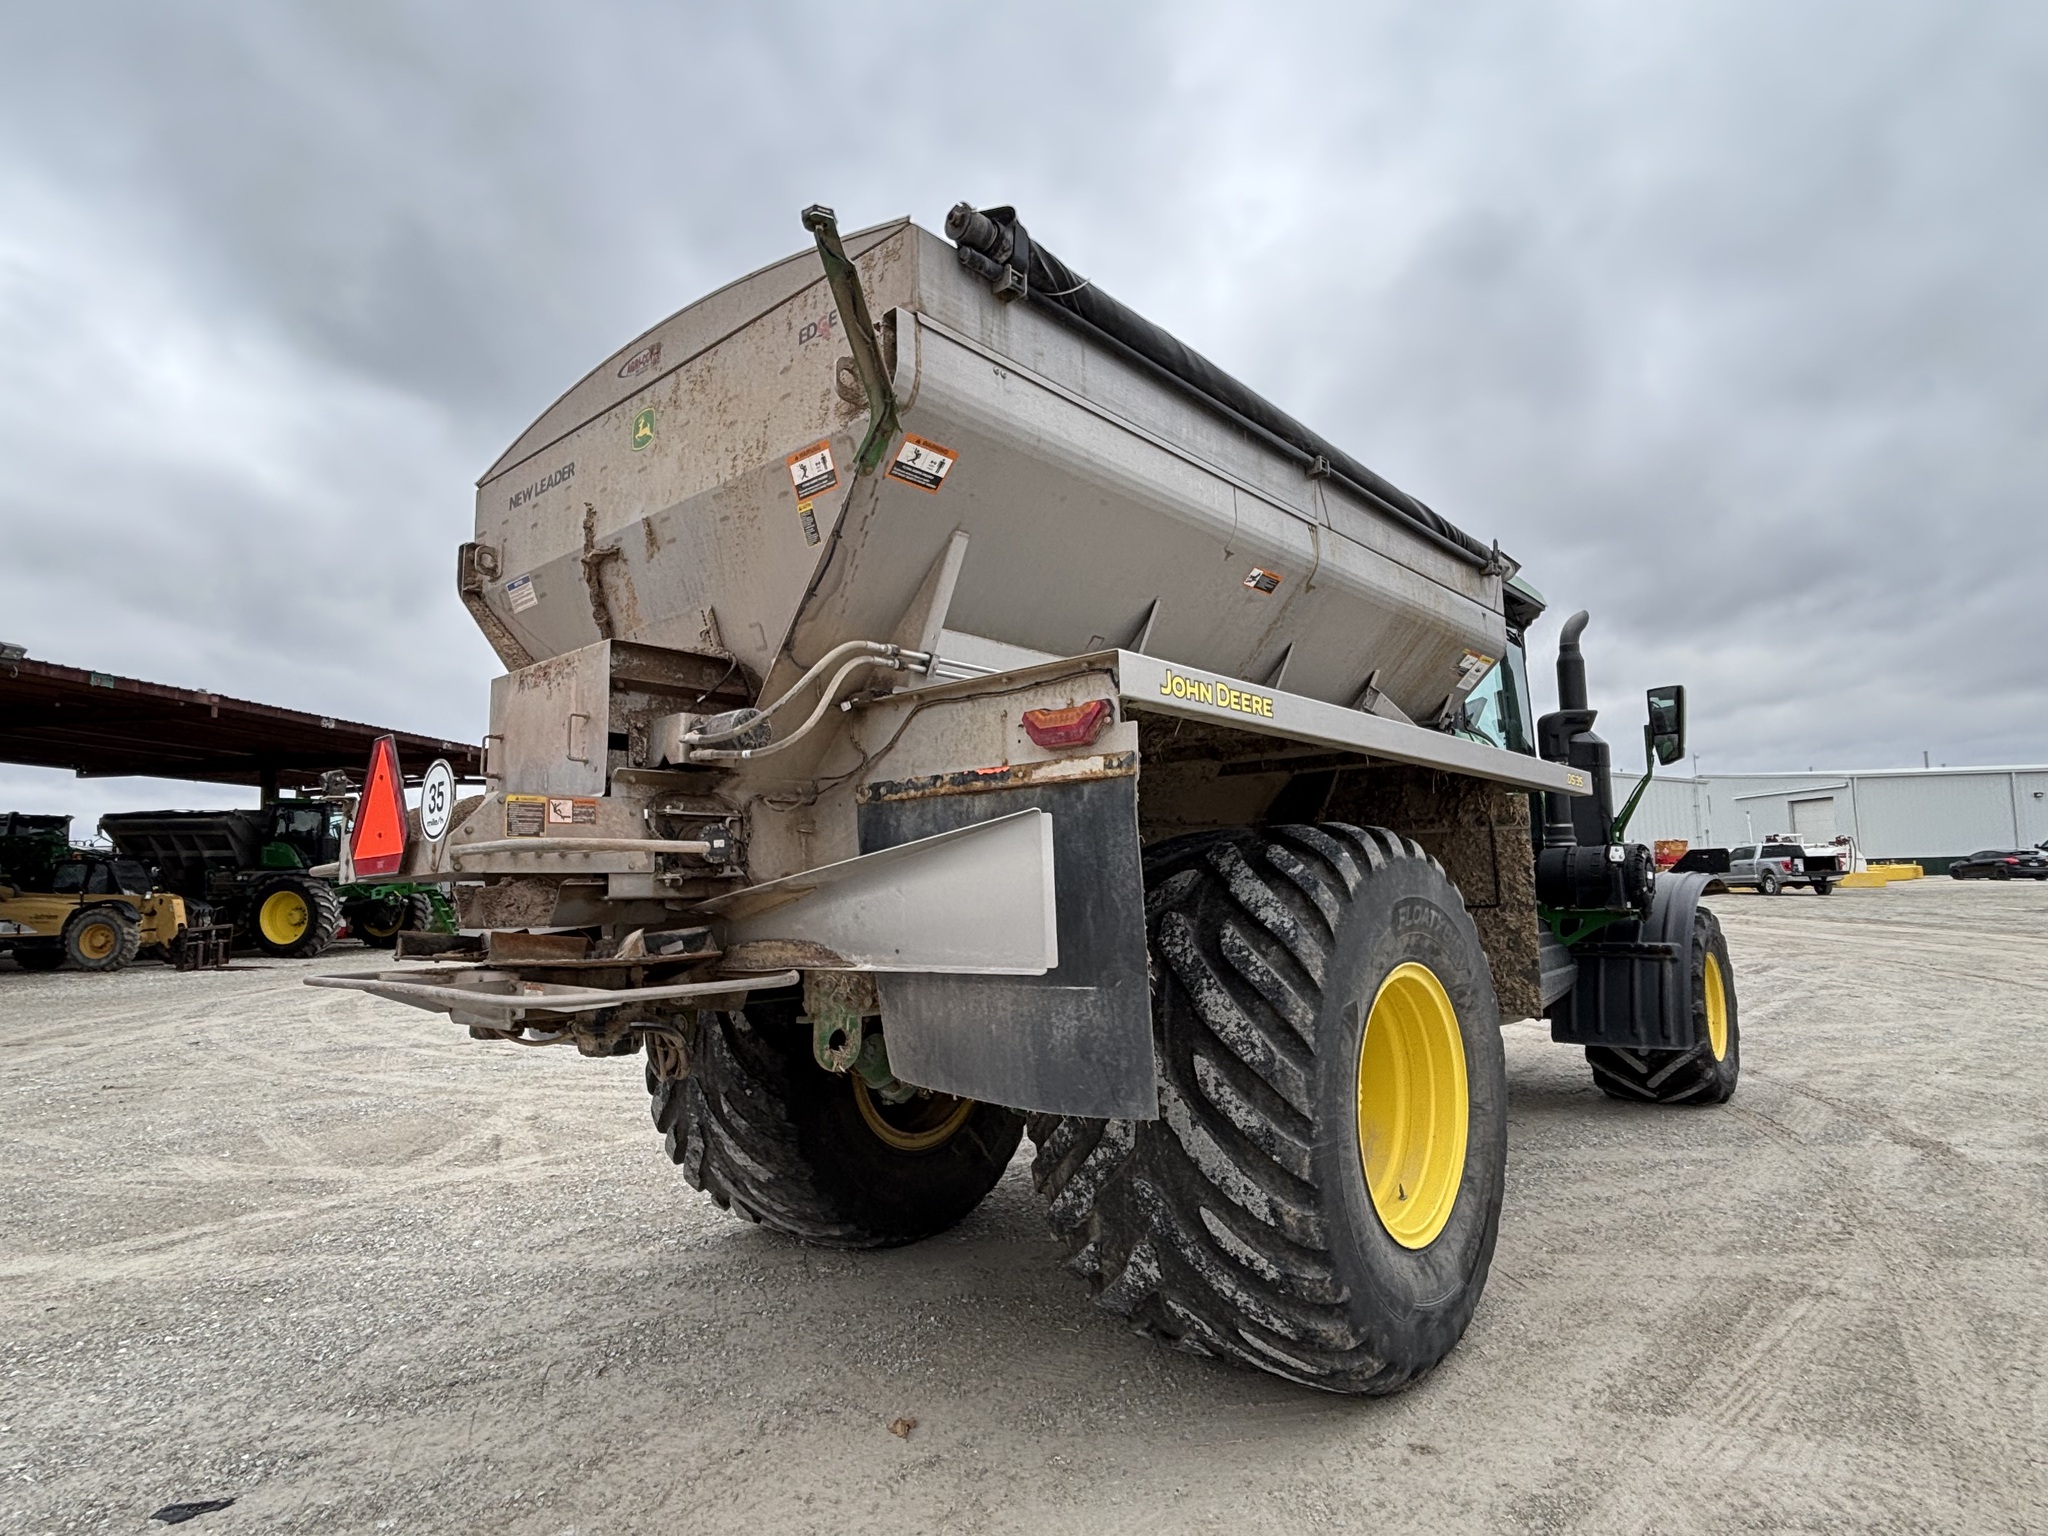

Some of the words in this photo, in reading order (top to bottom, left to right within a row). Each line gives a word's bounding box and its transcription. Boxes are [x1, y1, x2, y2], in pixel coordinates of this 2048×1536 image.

[799, 309, 838, 345] EDGE
[508, 484, 534, 511] NEW
[534, 461, 576, 498] LEADER
[1160, 669, 1213, 705] JOHN
[1216, 681, 1274, 719] DEERE
[428, 781, 445, 814] 35
